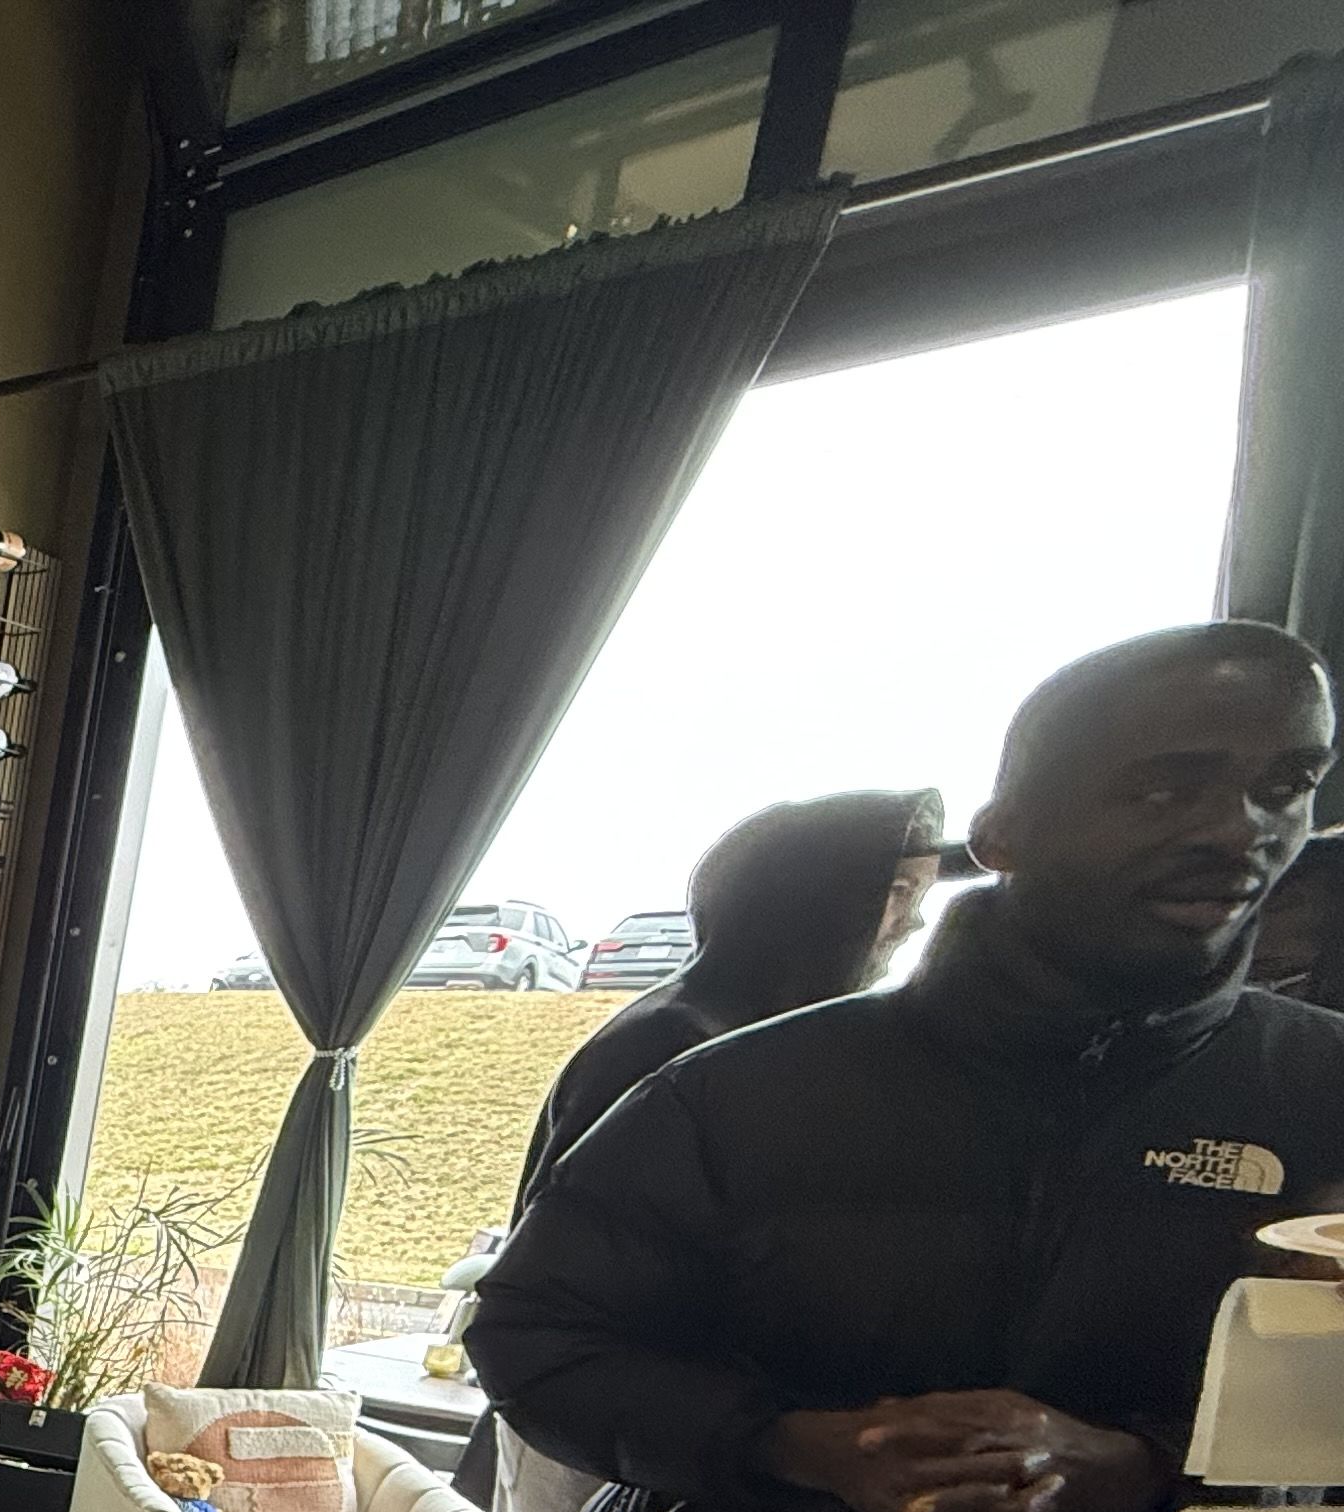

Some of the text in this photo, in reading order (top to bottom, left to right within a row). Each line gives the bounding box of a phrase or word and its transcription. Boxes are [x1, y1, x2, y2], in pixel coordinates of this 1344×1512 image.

[1193, 1138, 1244, 1160] THE
[1144, 1150, 1237, 1175] NORTH
[1168, 1168, 1234, 1191] FACE
